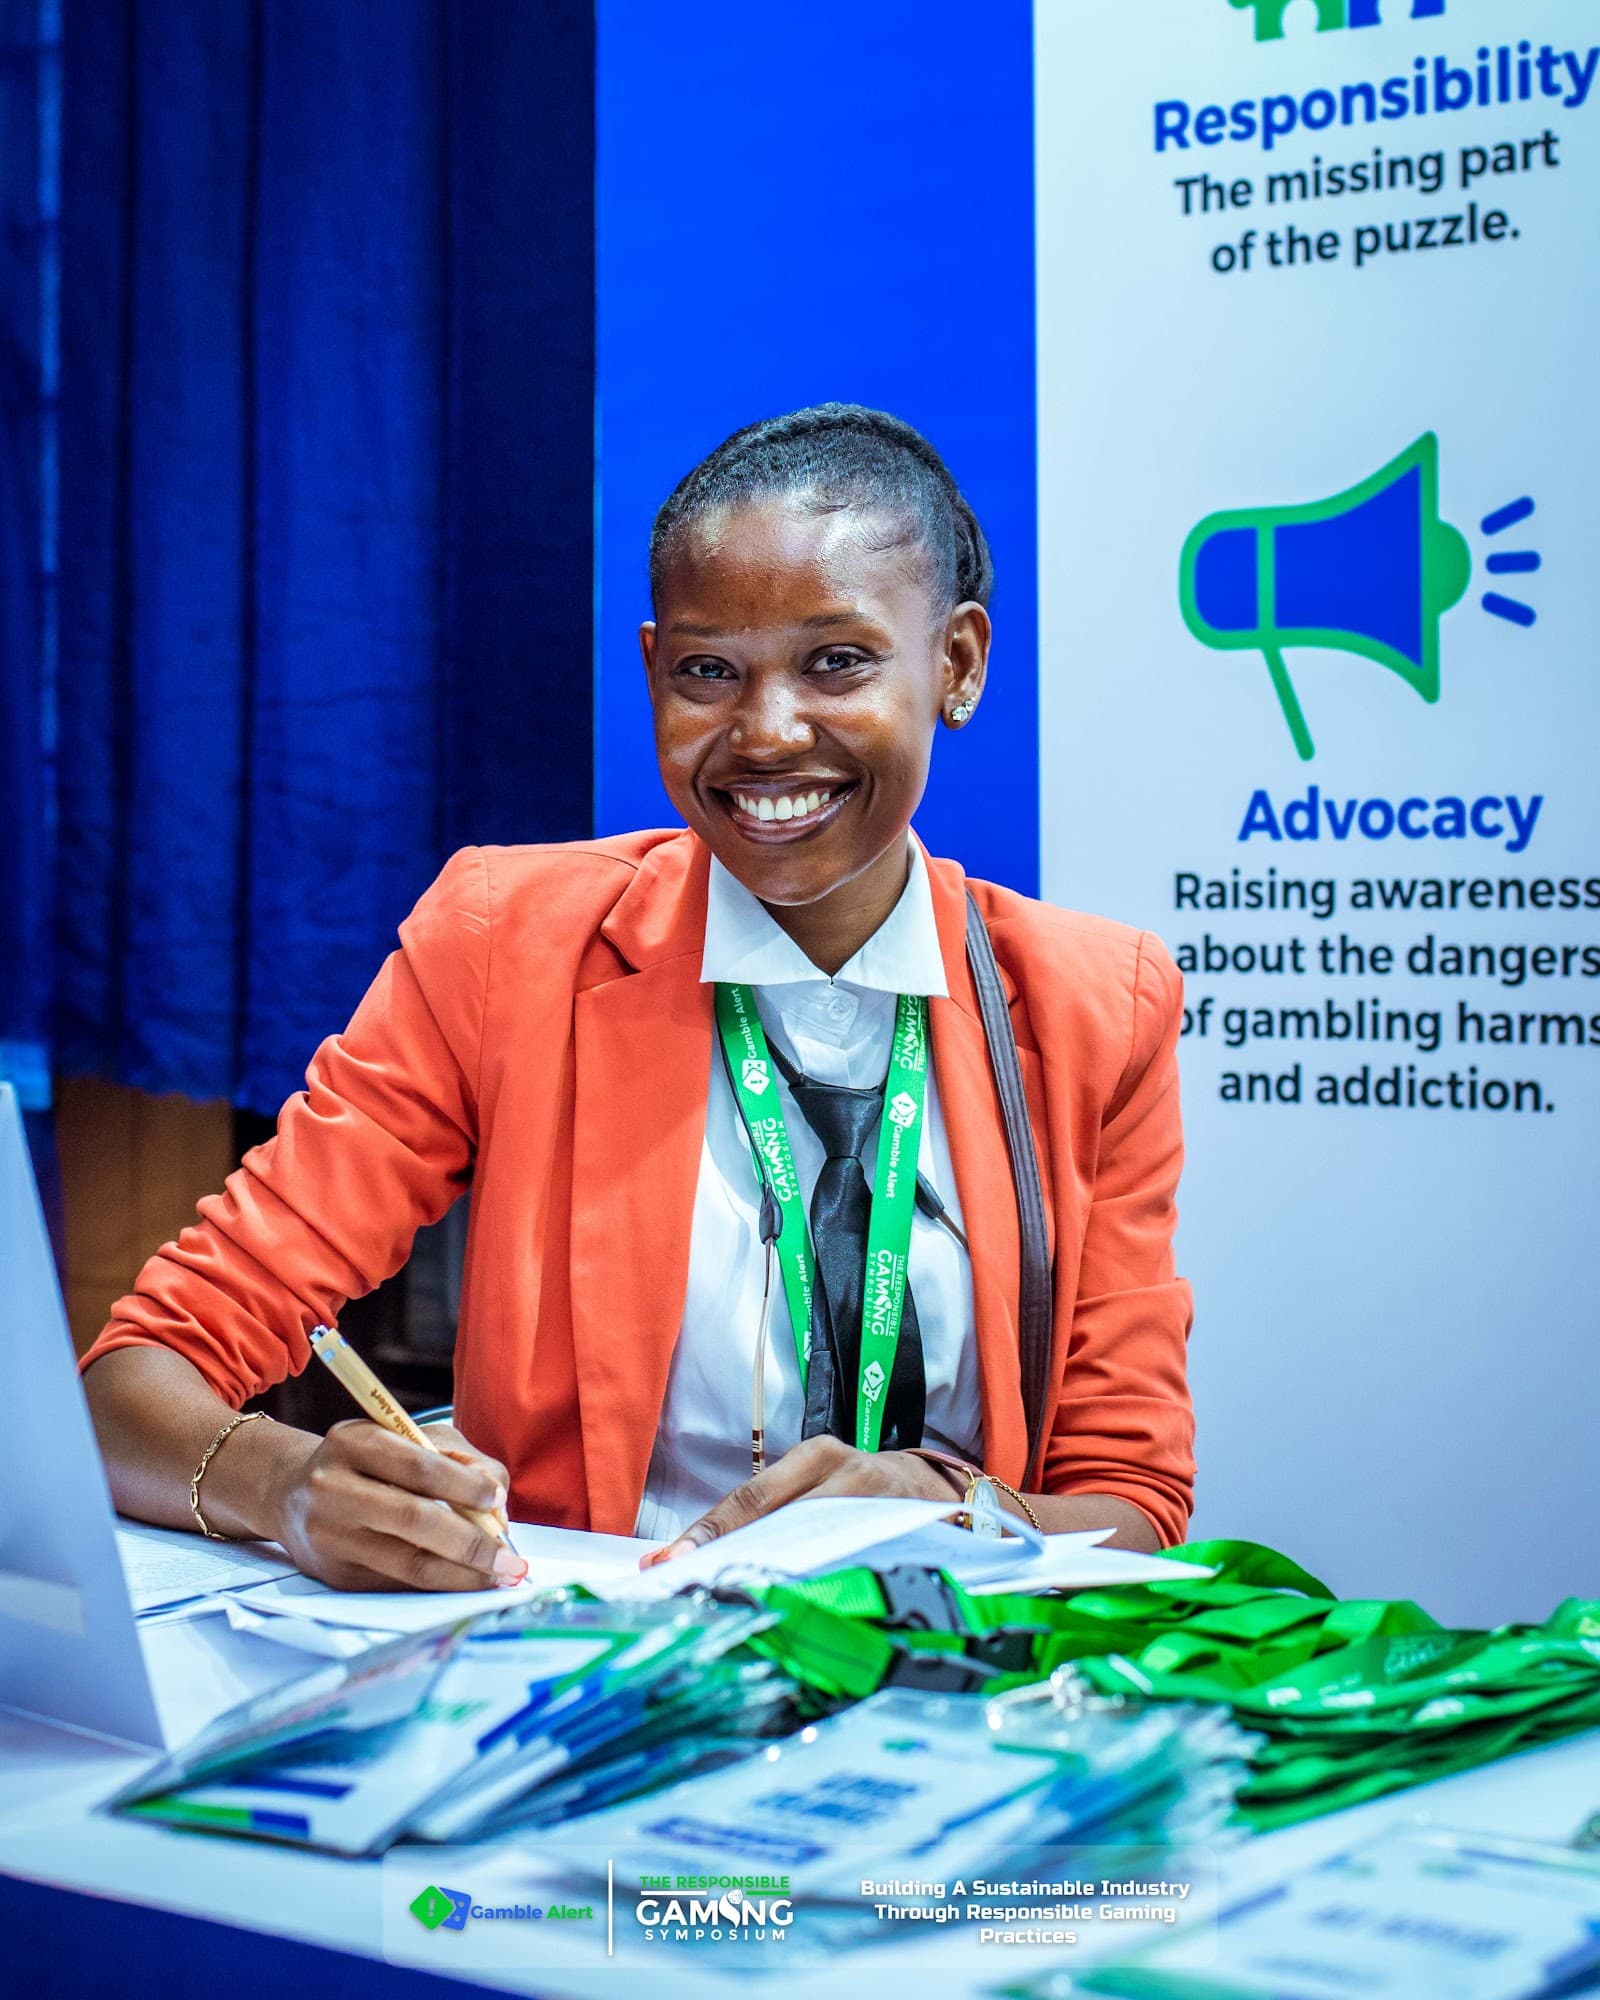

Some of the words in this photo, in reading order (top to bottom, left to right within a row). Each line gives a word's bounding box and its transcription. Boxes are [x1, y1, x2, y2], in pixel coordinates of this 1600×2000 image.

[1153, 40, 1600, 153] Responsibility
[1175, 173, 1253, 216] The
[1267, 149, 1444, 204] missing
[1459, 130, 1560, 189] part
[1212, 231, 1257, 273] of
[1267, 226, 1340, 267] the
[1354, 203, 1521, 267] puzzle.
[1237, 786, 1544, 853] Advocacy
[1174, 868, 1336, 919] Raising
[1350, 877, 1600, 911] awareness
[1176, 934, 1306, 975] about
[1319, 934, 1393, 976] the
[1407, 934, 1600, 987] dangers
[739, 1016, 757, 1059] Gamble
[1223, 998, 1441, 1051] gambling
[1220, 1063, 1302, 1103] and
[1316, 1065, 1555, 1113] addiction.
[888, 1124, 904, 1169] Gamble
[885, 1169, 898, 1199] Alert
[896, 1254, 905, 1272] THE
[864, 1252, 877, 1329] SYMPOSIUM
[889, 1273, 903, 1337] RESPONSIBLE
